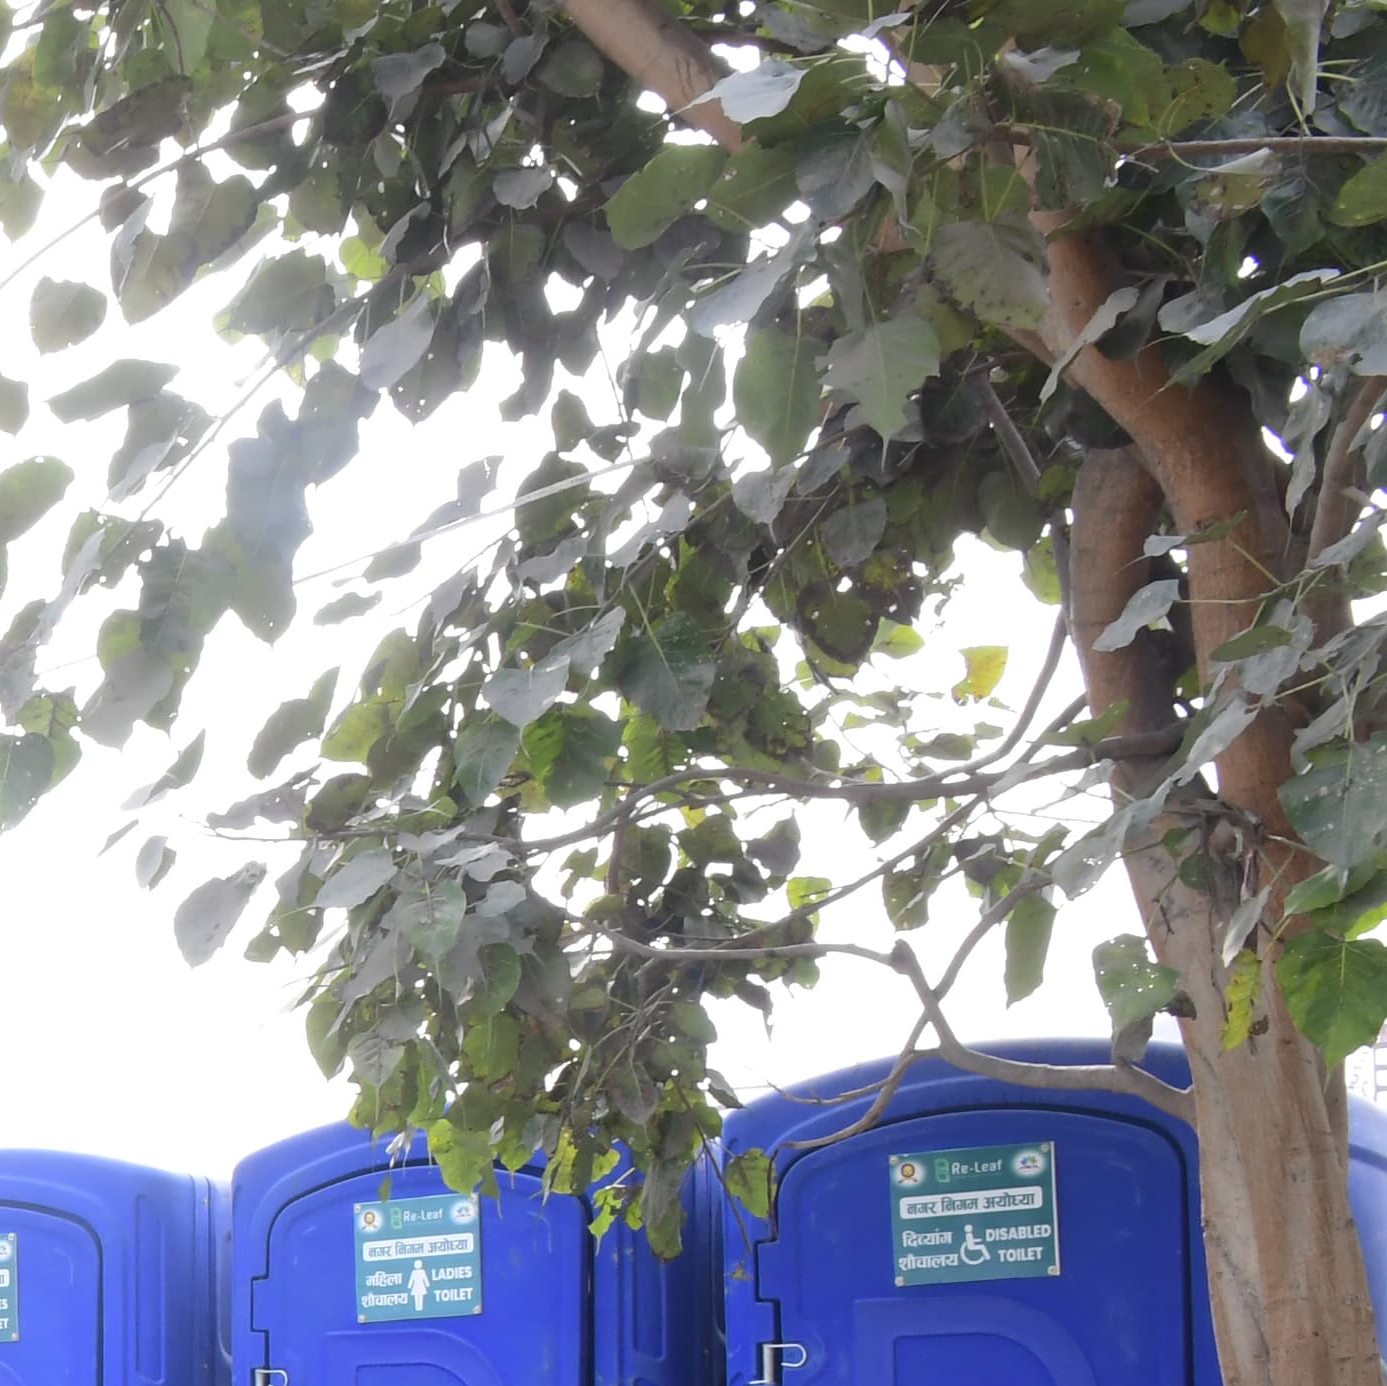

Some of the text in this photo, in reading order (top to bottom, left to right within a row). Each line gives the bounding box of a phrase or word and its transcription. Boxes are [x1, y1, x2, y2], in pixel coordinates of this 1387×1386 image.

[951, 1159, 1003, 1175] Re-Leaf
[906, 1191, 1036, 1215] नगर निगम अयोध्या
[403, 1208, 444, 1222] Re-Leaf
[902, 1228, 953, 1248] दिव्यांग
[985, 1224, 1052, 1242] DISABLED
[997, 1246, 1044, 1263] TOILET
[365, 1270, 403, 1287] महिला
[431, 1266, 473, 1281] LADIES
[433, 1287, 474, 1303] TOILET
